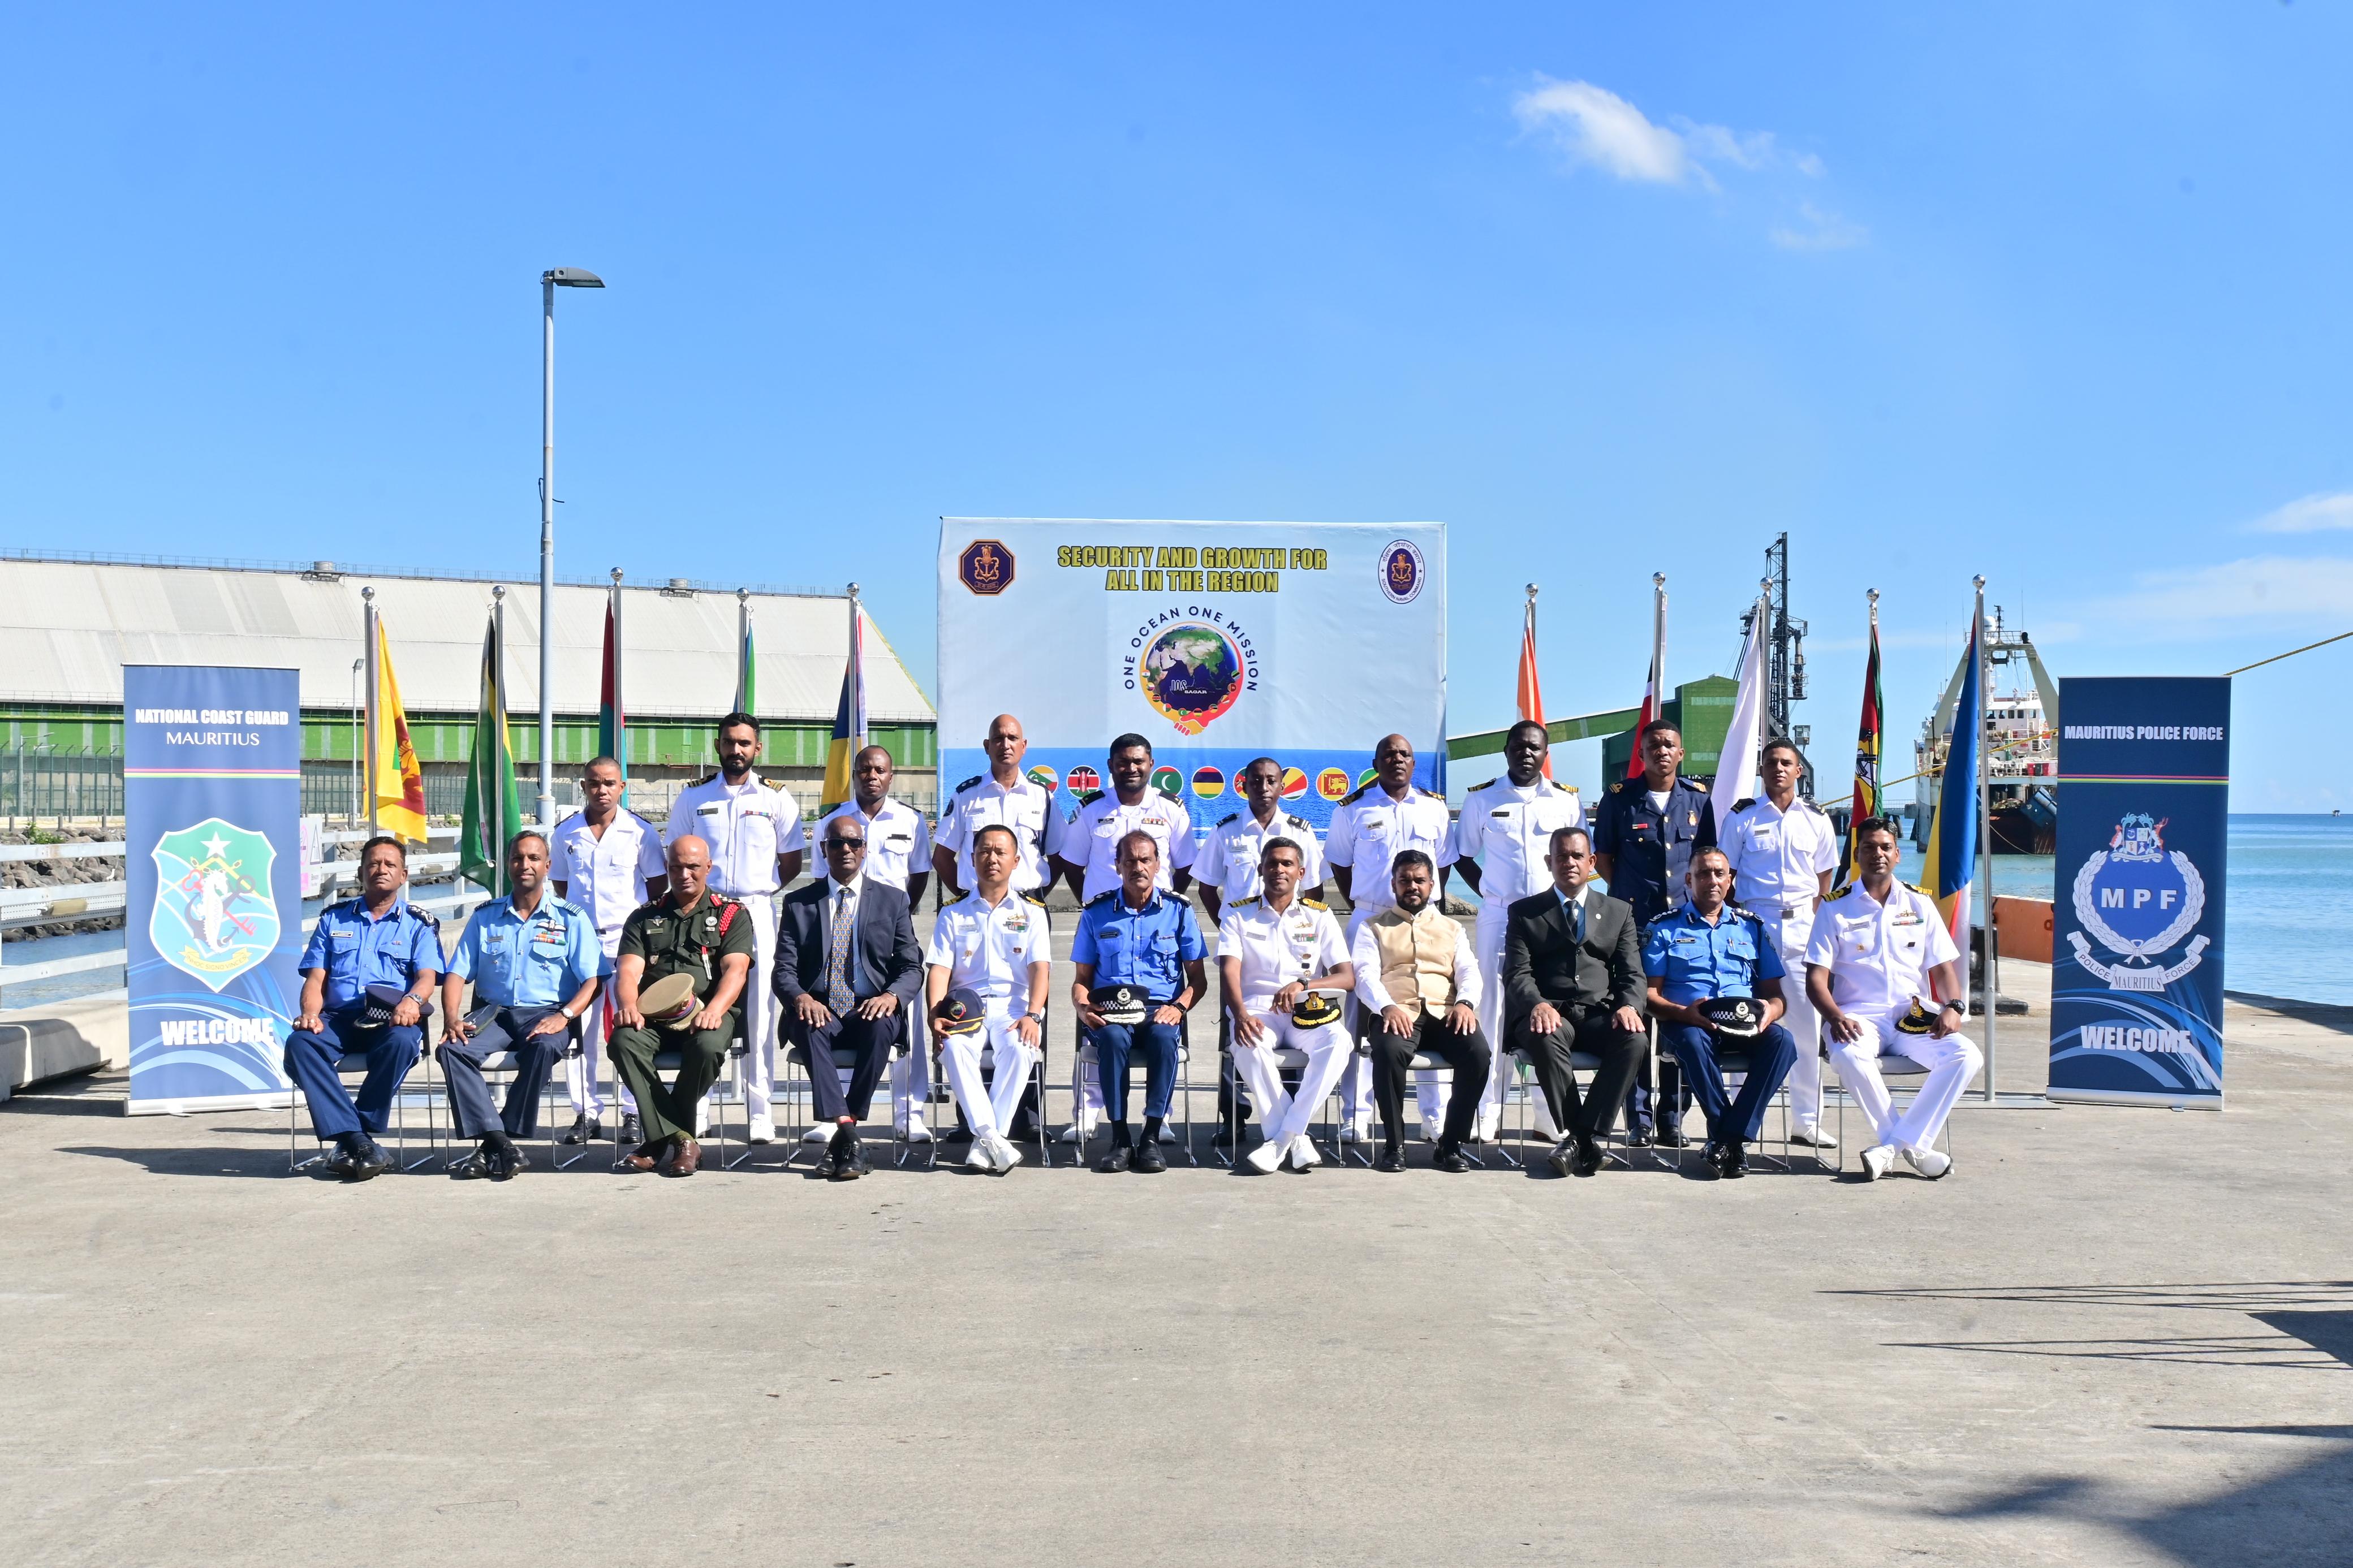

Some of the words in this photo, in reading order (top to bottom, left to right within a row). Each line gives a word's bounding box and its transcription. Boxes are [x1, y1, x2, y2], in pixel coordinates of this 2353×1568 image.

[1057, 546, 1153, 567] SECURITY
[1156, 547, 1197, 568] AND
[1201, 547, 1286, 569] GROWTH
[1290, 548, 1327, 570] FOR
[1105, 570, 1139, 591] ALL
[1141, 570, 1163, 591] IN
[1167, 571, 1203, 591] THE
[1207, 571, 1278, 593] REGION
[1381, 578, 1396, 599] SOUTHERN
[1409, 577, 1422, 598] COMMAND
[1123, 655, 1135, 690] ONE
[1131, 607, 1180, 647] OCEAN
[1188, 606, 1223, 623] ONE
[1227, 621, 1259, 691] MISSION
[135, 709, 199, 724] NATIONAL
[201, 710, 243, 724] COAST
[245, 710, 289, 725] GUARD
[166, 732, 260, 746] MAURITIUS
[2065, 725, 2135, 740] MAURITIUS
[2137, 726, 2180, 740] POLICE
[2183, 727, 2223, 741] FORCE
[2079, 954, 2110, 979] POLICE
[2165, 958, 2197, 980] FORCE
[2114, 976, 2162, 990] MAURITIUS
[160, 1018, 274, 1046] WELCOME
[2080, 1026, 2191, 1053] WELCOME
